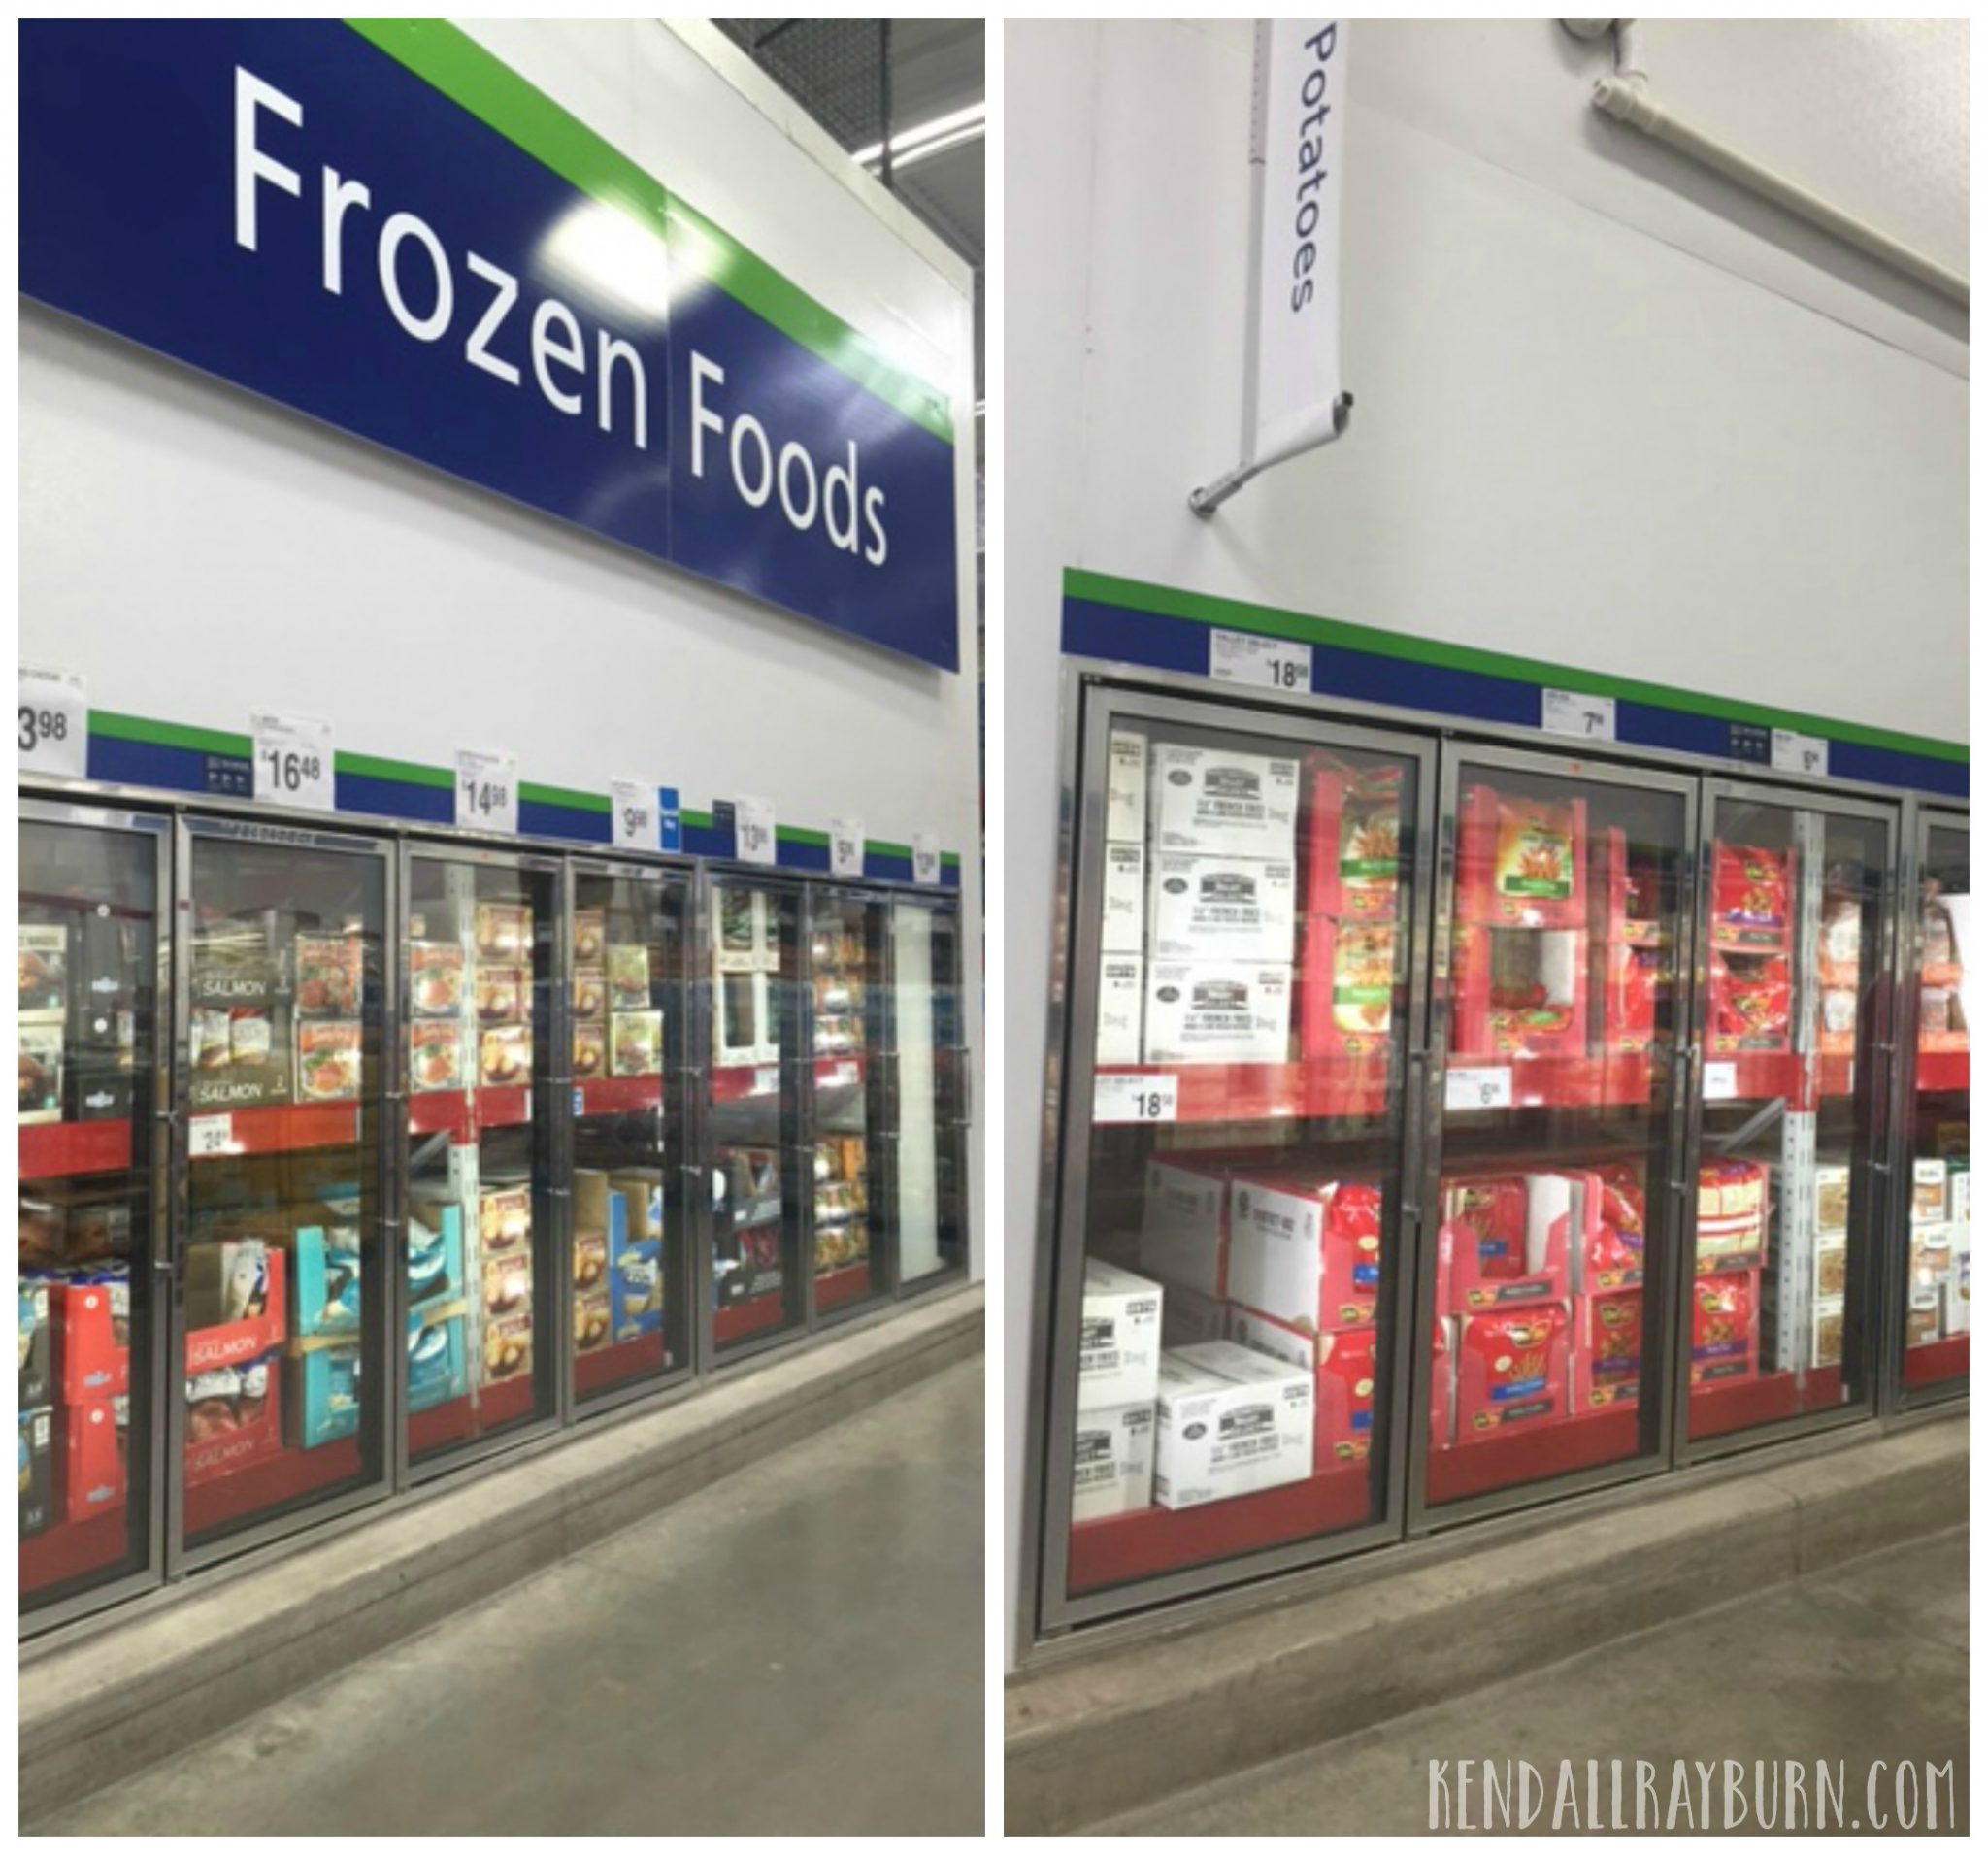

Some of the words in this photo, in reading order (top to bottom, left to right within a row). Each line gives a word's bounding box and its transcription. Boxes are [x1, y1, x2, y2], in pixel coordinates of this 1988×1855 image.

[1290, 20, 1338, 315] Potatoes
[235, 64, 647, 450] Frozen
[690, 349, 888, 567] Foods
[202, 980, 266, 998] SALMON
[199, 1082, 263, 1104] SALMON
[193, 1336, 256, 1366] SALMON
